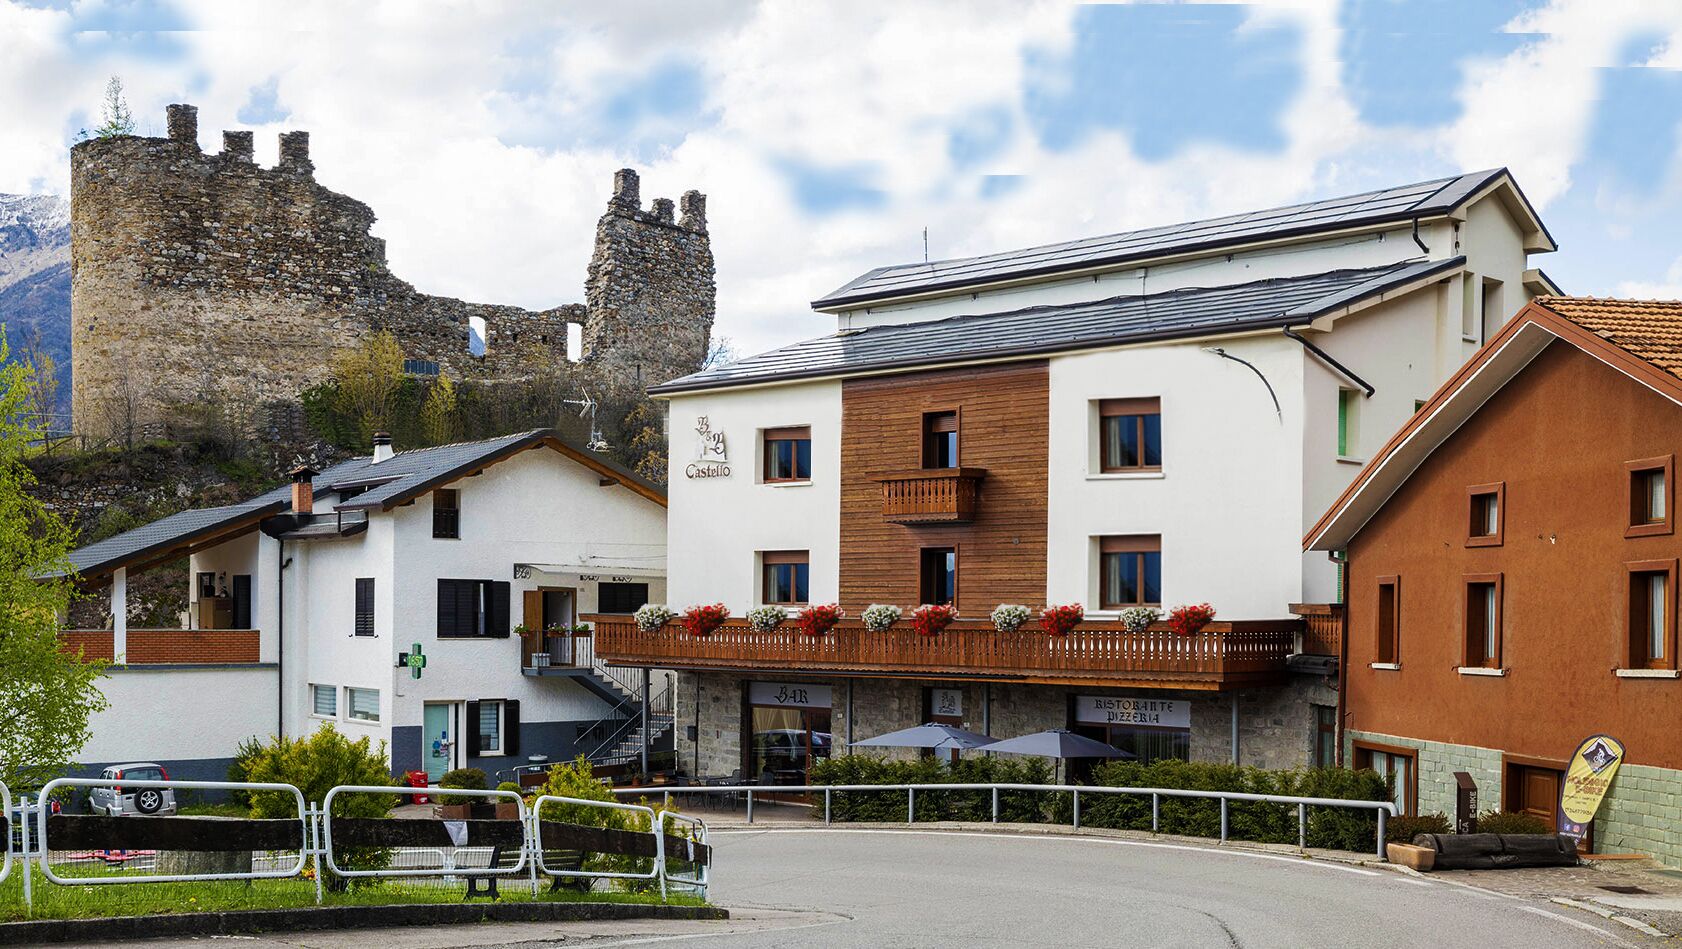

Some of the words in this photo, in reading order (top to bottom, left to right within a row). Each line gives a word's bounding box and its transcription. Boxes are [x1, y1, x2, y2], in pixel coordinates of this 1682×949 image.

[686, 464, 730, 479] Castello
[773, 686, 808, 703] BAR
[1094, 699, 1173, 712] RISTORANTE
[1107, 711, 1159, 723] PIZZERIA
[1469, 791, 1477, 819] E-BIKE
